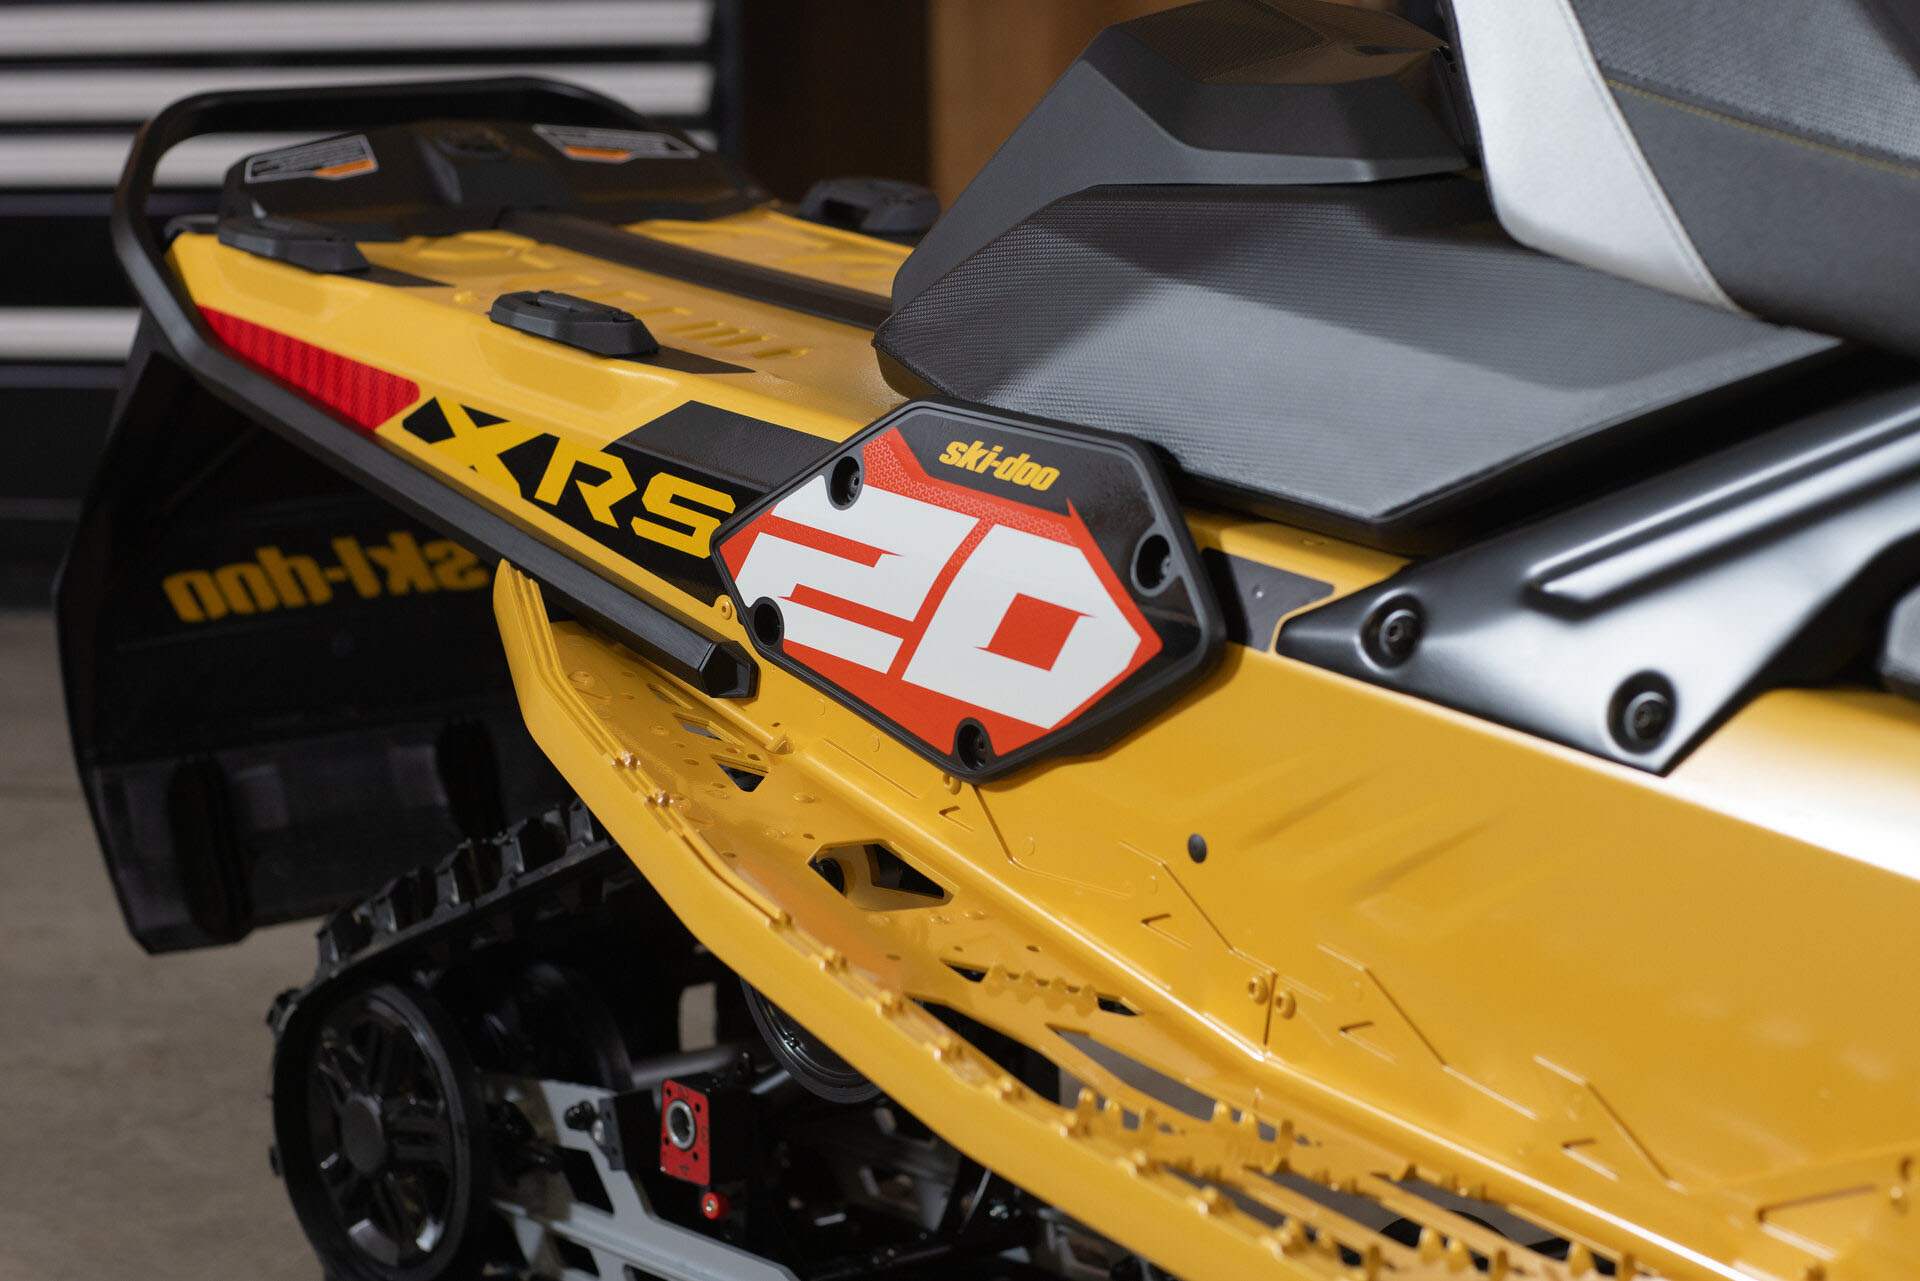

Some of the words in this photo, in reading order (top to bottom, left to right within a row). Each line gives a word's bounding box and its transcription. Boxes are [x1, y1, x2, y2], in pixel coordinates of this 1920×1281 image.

[424, 397, 737, 560] XRS
[938, 440, 1060, 491] ski-doo
[736, 475, 1142, 729] 20
